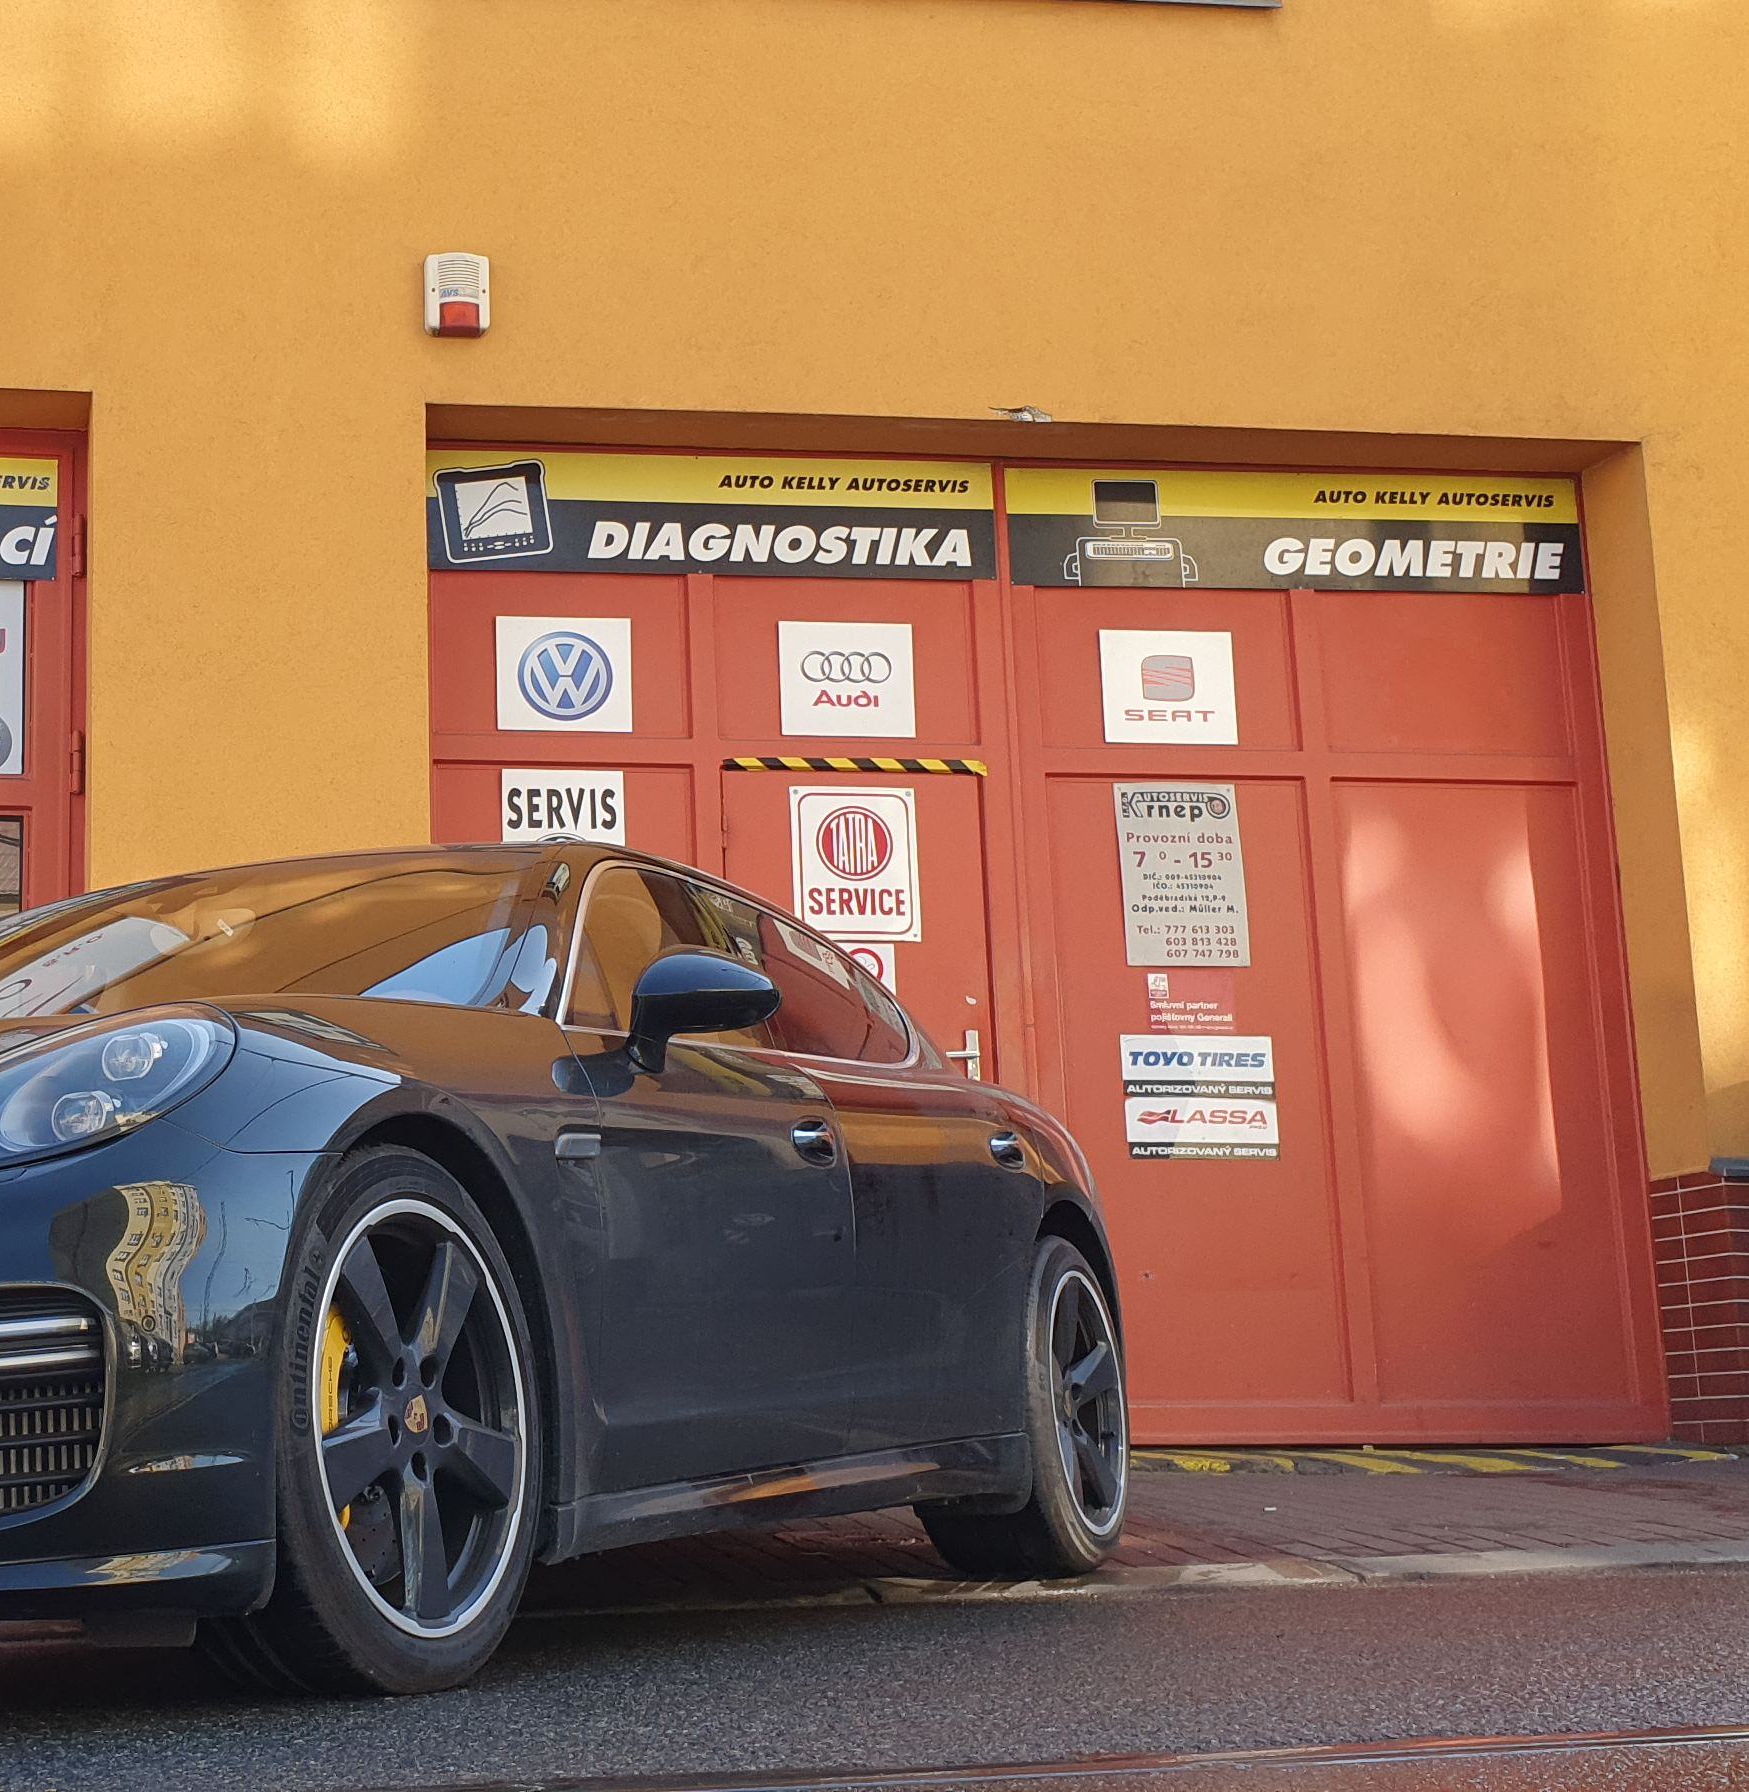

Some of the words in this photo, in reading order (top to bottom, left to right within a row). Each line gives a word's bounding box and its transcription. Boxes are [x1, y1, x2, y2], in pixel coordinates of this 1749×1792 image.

[718, 474, 774, 490] AUTO
[781, 475, 842, 491] KELLY
[845, 476, 970, 494] AUTOSERVIS
[1313, 489, 1368, 504] AUTO
[1374, 490, 1432, 506] KELLY
[1436, 492, 1555, 508] AUTOSERVIS
[586, 520, 973, 568] DIAGNOSTIKA
[1263, 537, 1565, 580] GEOMETRIE
[812, 689, 879, 708] Audi
[1123, 708, 1215, 723] SEAT
[1133, 792, 1209, 802] AUTOSERVIS
[506, 787, 617, 832] SERVIS
[829, 812, 878, 876] TATRA
[1126, 832, 1191, 844] Provozní
[1197, 832, 1233, 844] doba
[1132, 850, 1146, 868] 7
[808, 886, 906, 917] SERVICE
[1226, 904, 1239, 914] M.
[1164, 924, 1187, 935] 777
[1191, 925, 1210, 935] 613
[1214, 925, 1235, 935] 303
[1165, 937, 1187, 947] 603
[1215, 937, 1237, 947] 428
[1166, 949, 1188, 958] 607
[1192, 949, 1213, 958] 747
[1217, 949, 1240, 959] 798
[1128, 1051, 1194, 1067] TOYO
[1197, 1052, 1267, 1068] TIRES
[1126, 1083, 1226, 1094] AUTORIZOVANÝ
[1228, 1085, 1273, 1095] SERVIS
[1169, 1109, 1269, 1125] LASSA
[1132, 1145, 1231, 1156] AUTORIZOVANÝ
[1233, 1147, 1277, 1157] SERVIS
[289, 1265, 321, 1434] Continental
